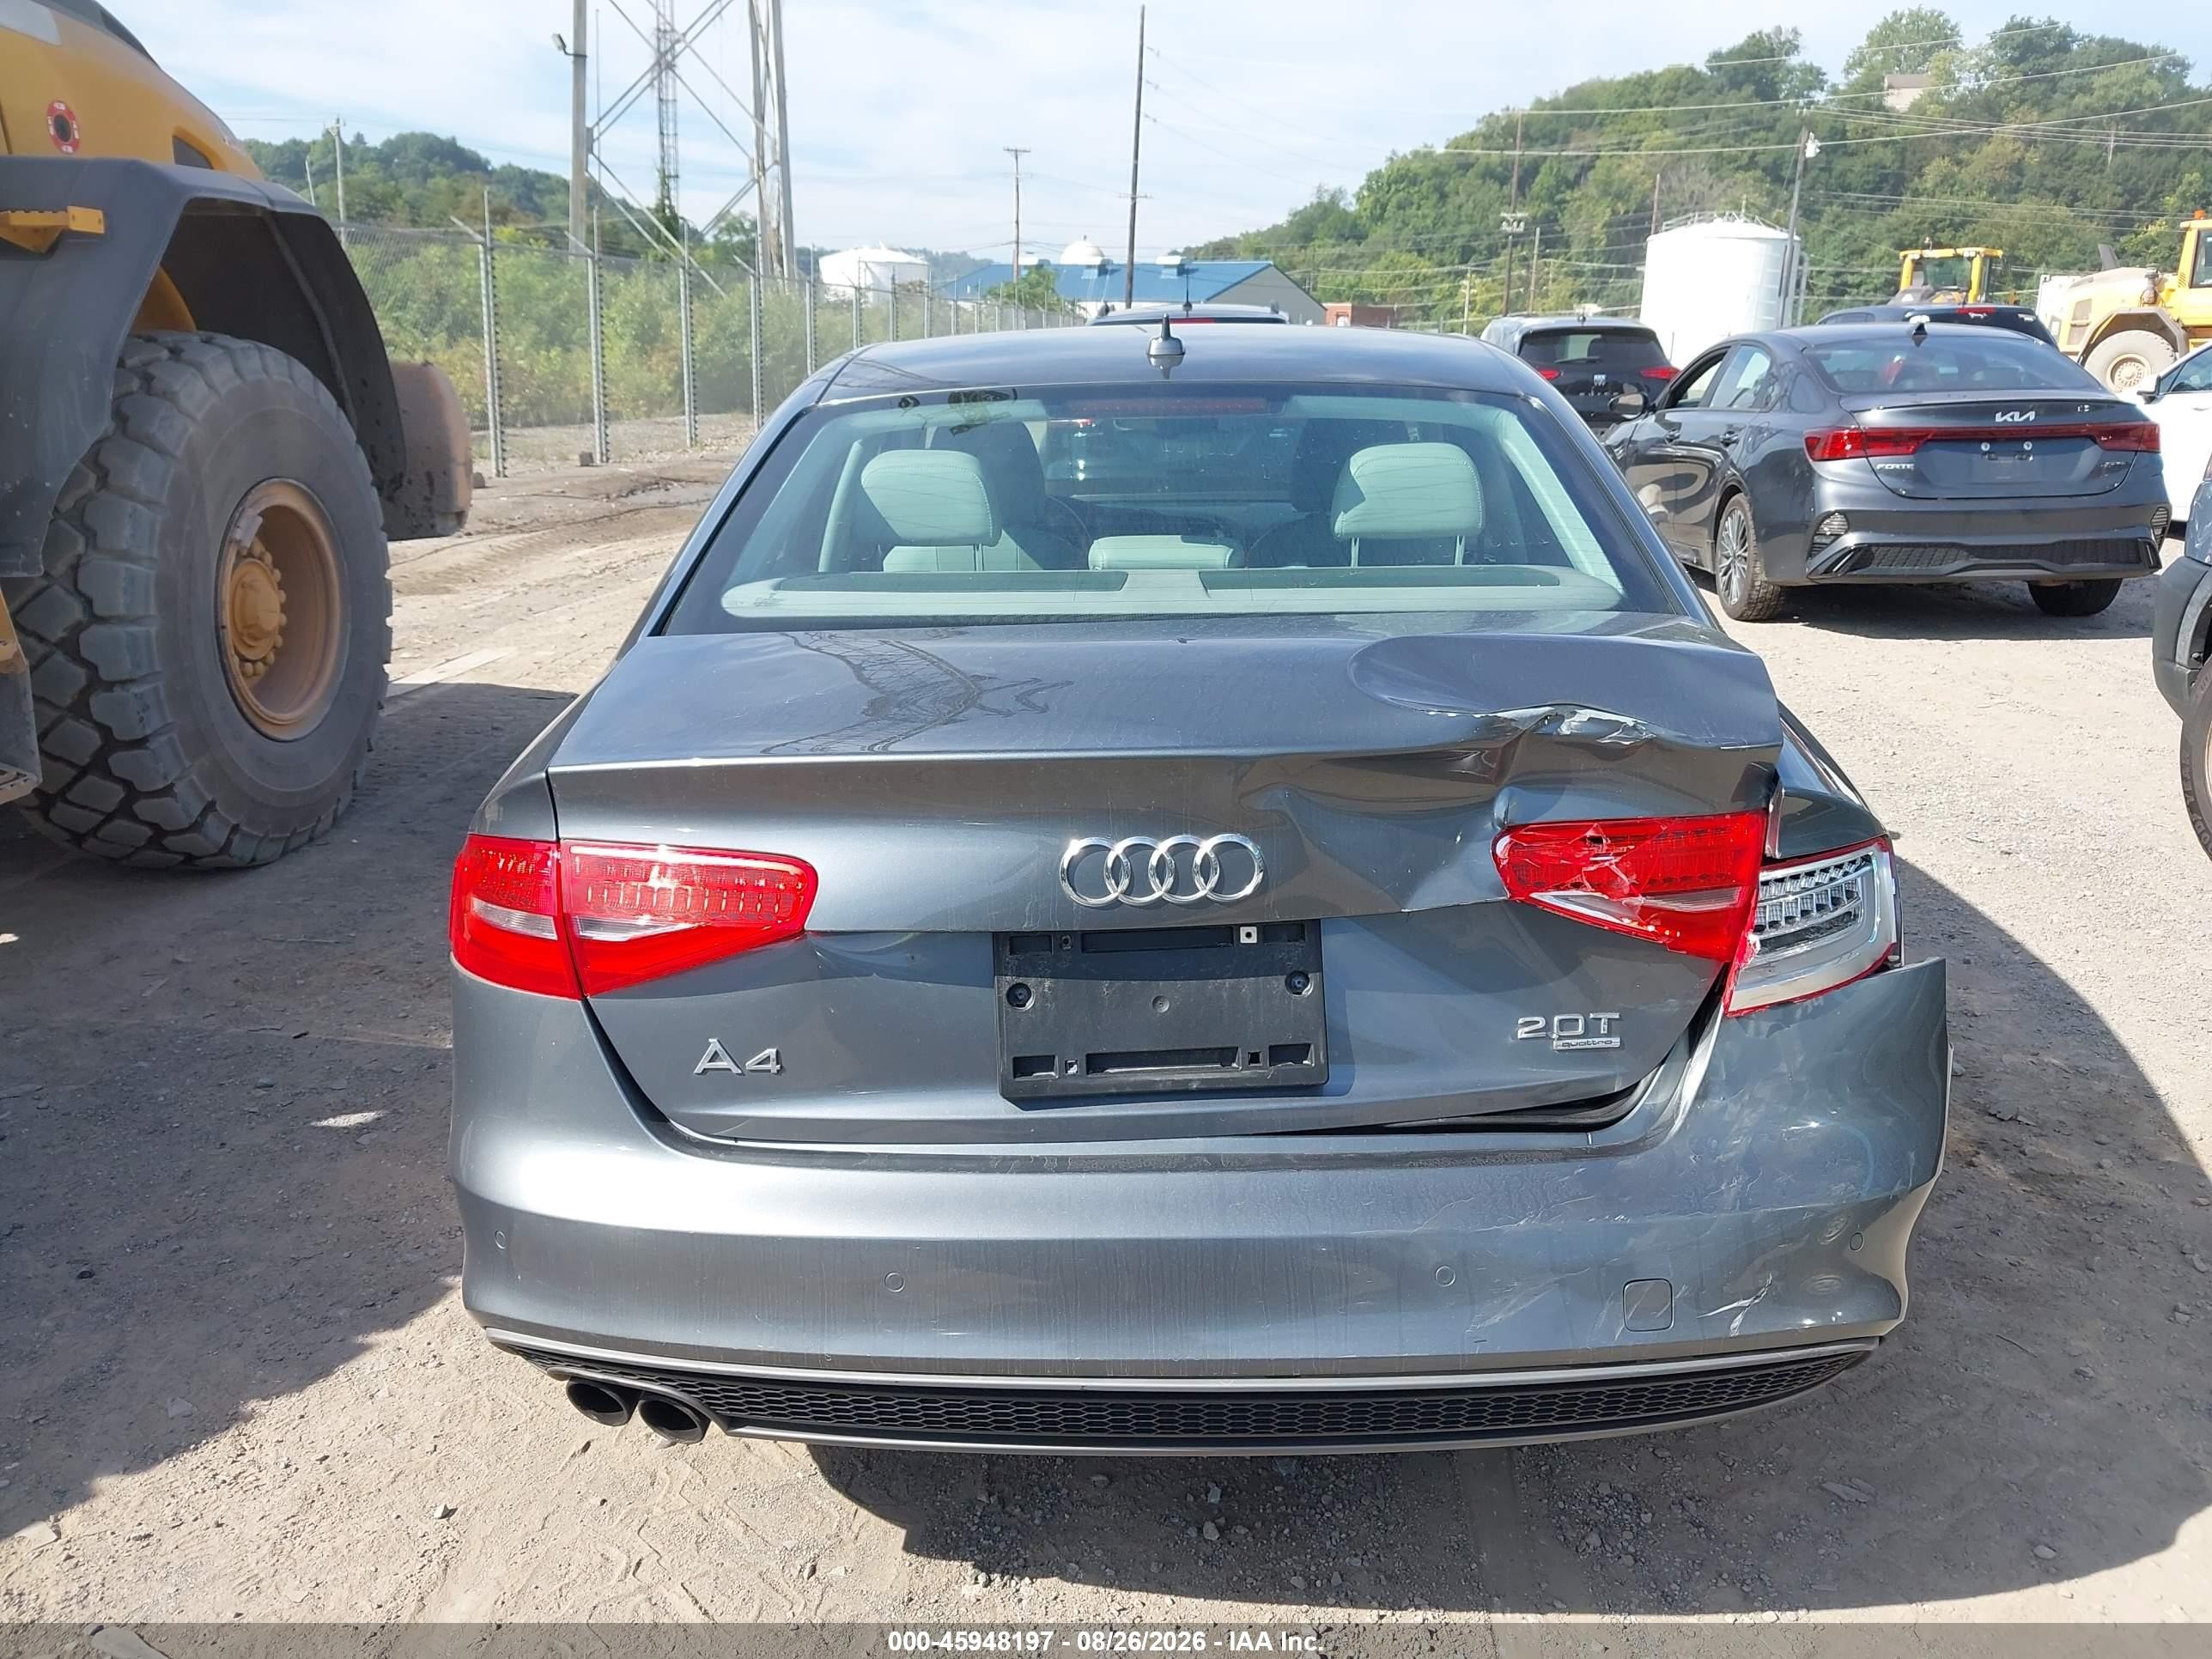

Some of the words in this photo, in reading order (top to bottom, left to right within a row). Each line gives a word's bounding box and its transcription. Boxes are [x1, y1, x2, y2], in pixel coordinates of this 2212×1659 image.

[1995, 410, 2036, 422] KIA
[1559, 1038, 1615, 1049] quattro
[693, 1037, 782, 1076] A4
